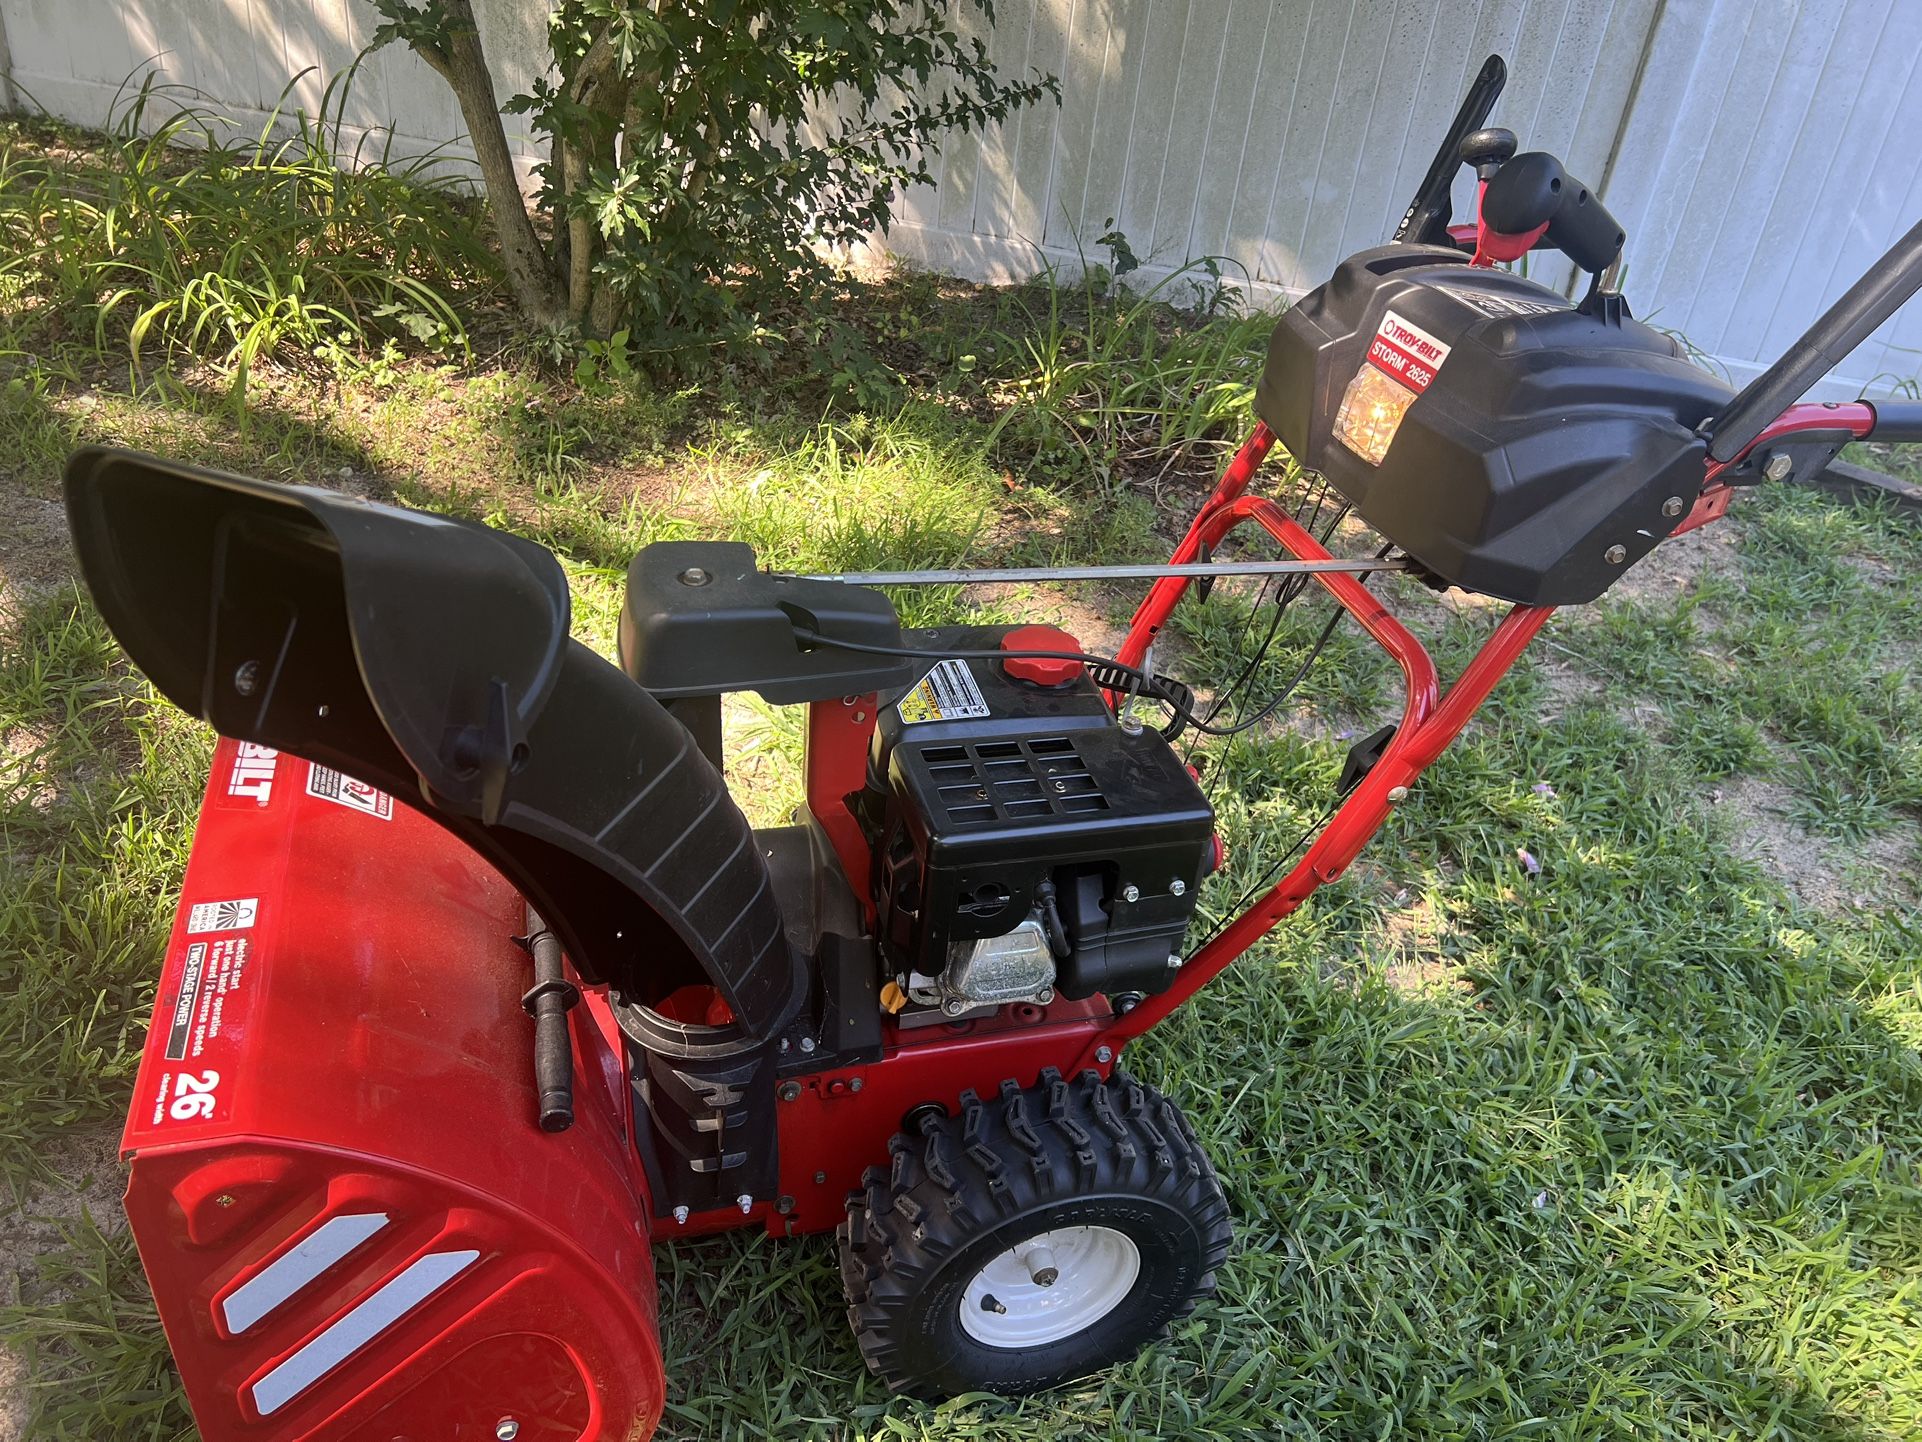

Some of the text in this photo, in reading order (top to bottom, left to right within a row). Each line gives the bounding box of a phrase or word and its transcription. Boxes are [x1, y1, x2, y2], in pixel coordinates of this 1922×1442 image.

[1392, 325, 1443, 362] TROY-BILT
[1405, 364, 1432, 387] 2625
[200, 905, 210, 931] AMERICA
[207, 948, 224, 979] forward
[221, 956, 232, 971] one
[224, 940, 237, 955] just
[182, 945, 203, 993] TWO-STAGE
[230, 938, 248, 990] electric start
[175, 994, 192, 1026] POWER
[199, 992, 213, 1023] reverse
[208, 997, 224, 1038] operation
[192, 1025, 207, 1057] speeds
[152, 1073, 171, 1125] clearing width
